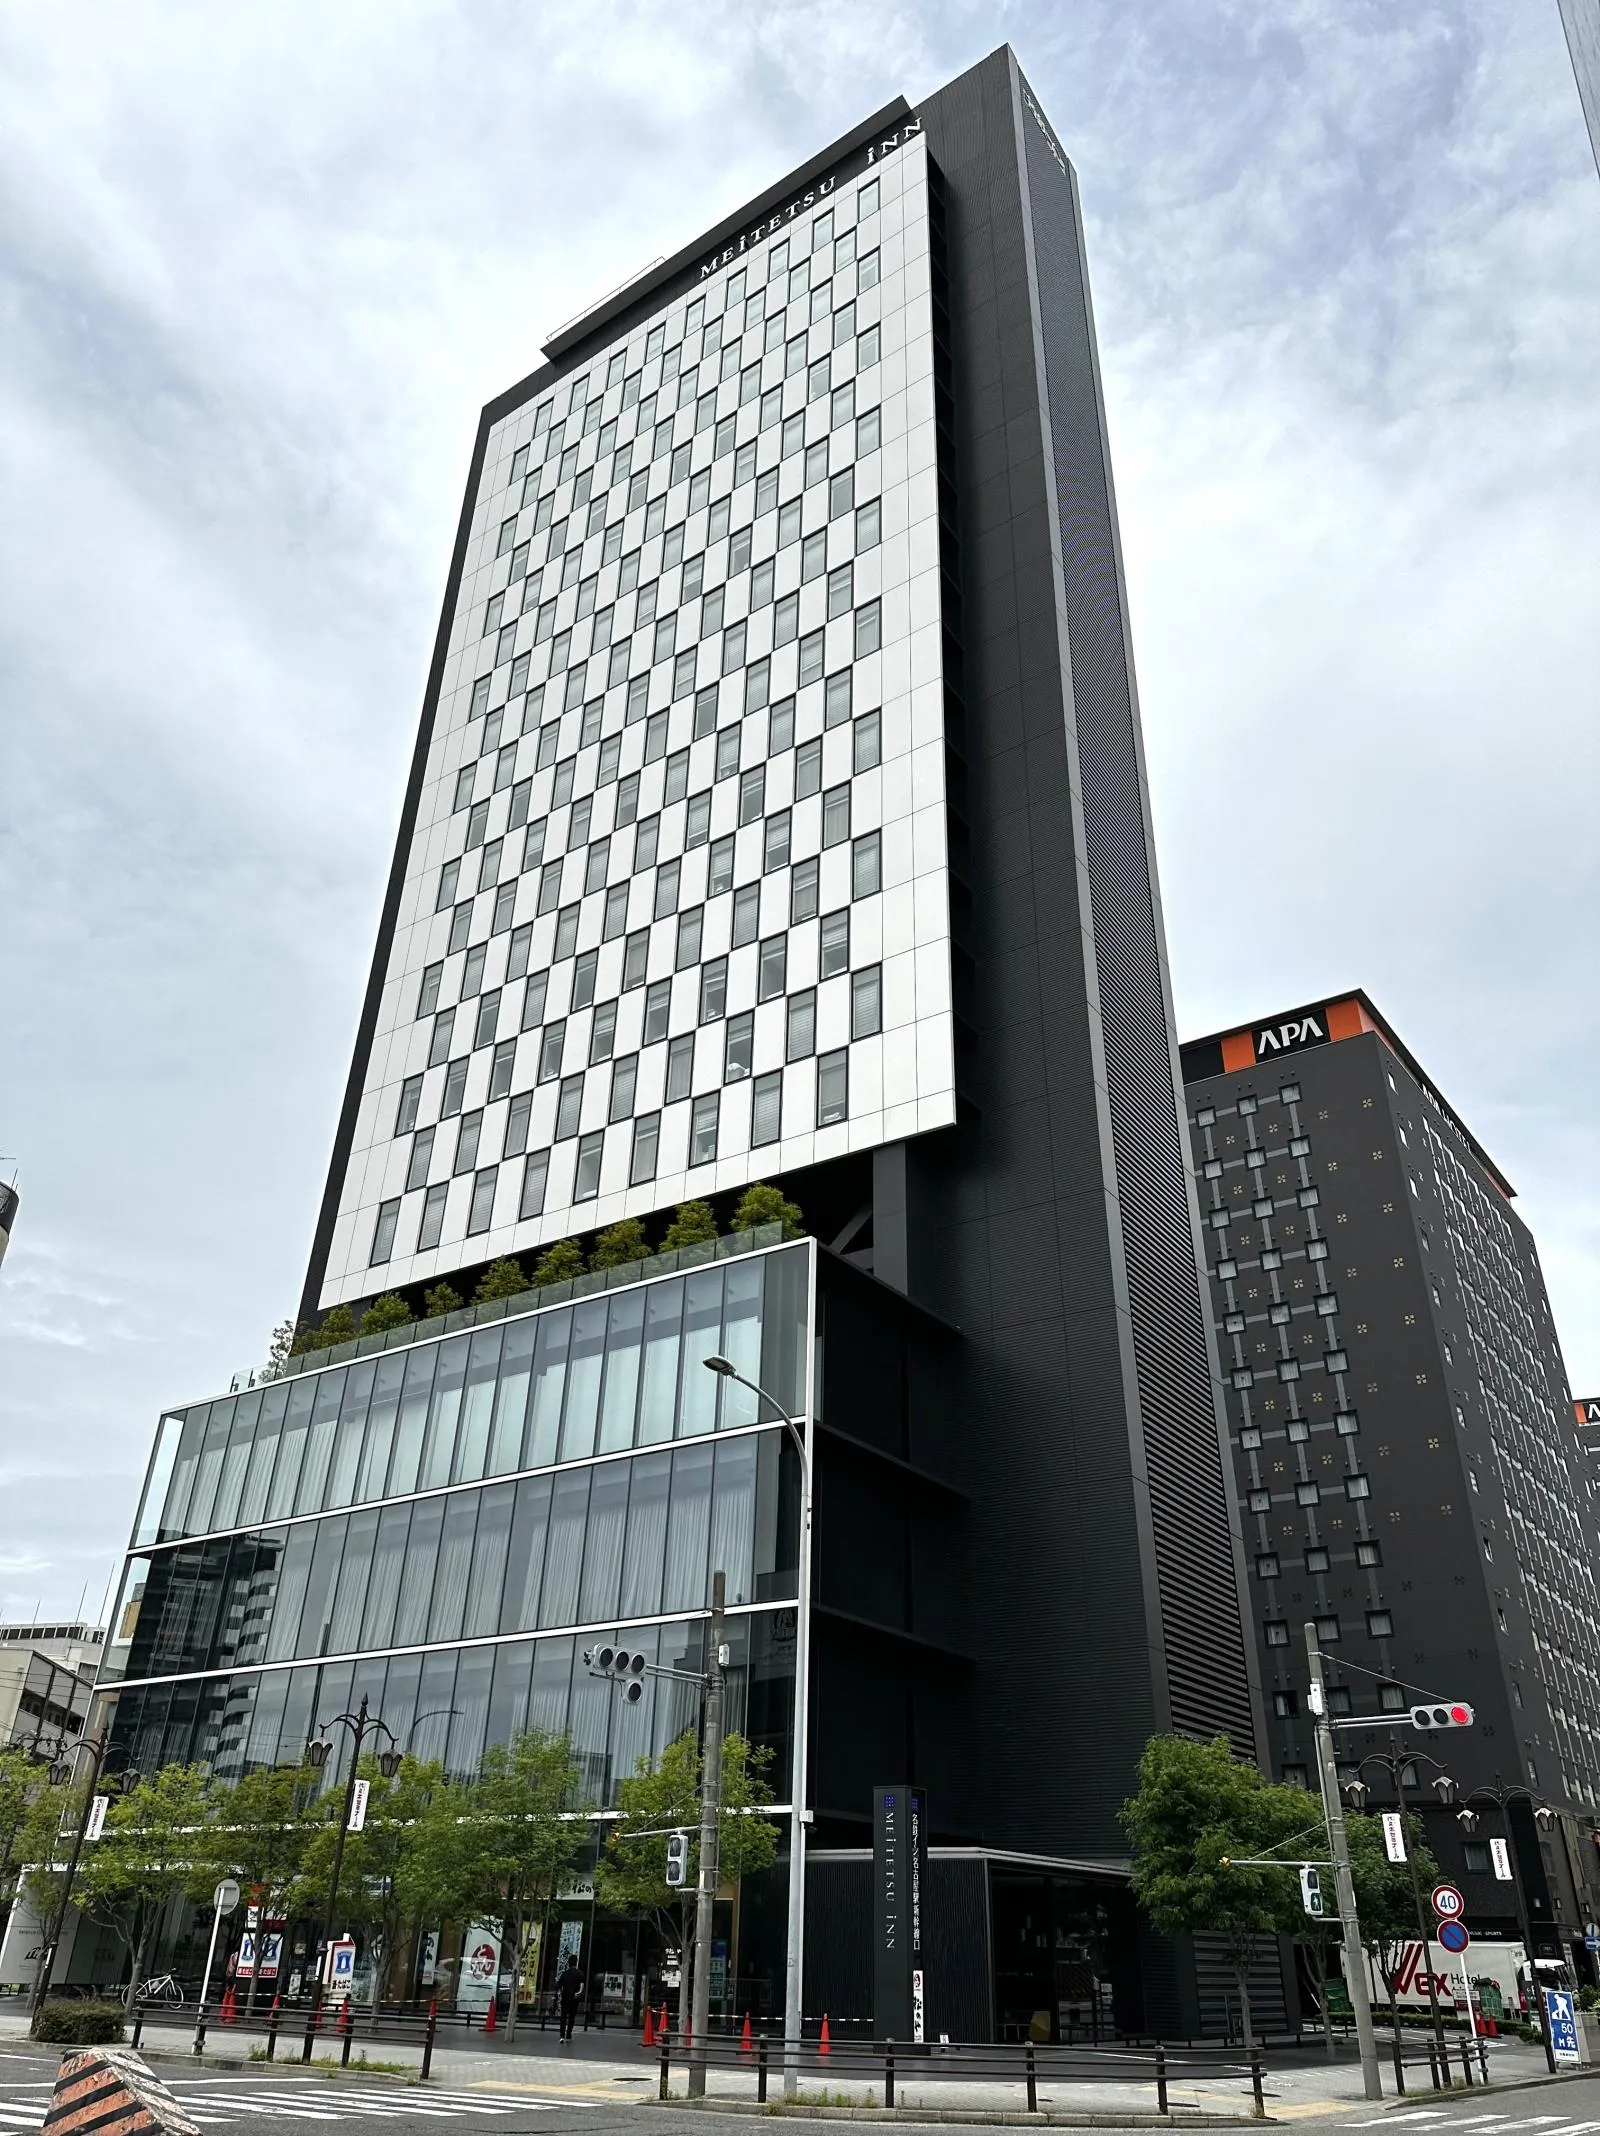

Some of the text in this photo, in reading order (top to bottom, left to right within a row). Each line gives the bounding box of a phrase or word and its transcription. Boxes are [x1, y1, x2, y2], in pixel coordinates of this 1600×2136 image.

[1258, 1016, 1324, 1055] APA
[1440, 1895, 1457, 1910] 40
[1561, 2022, 1574, 2035] 50
